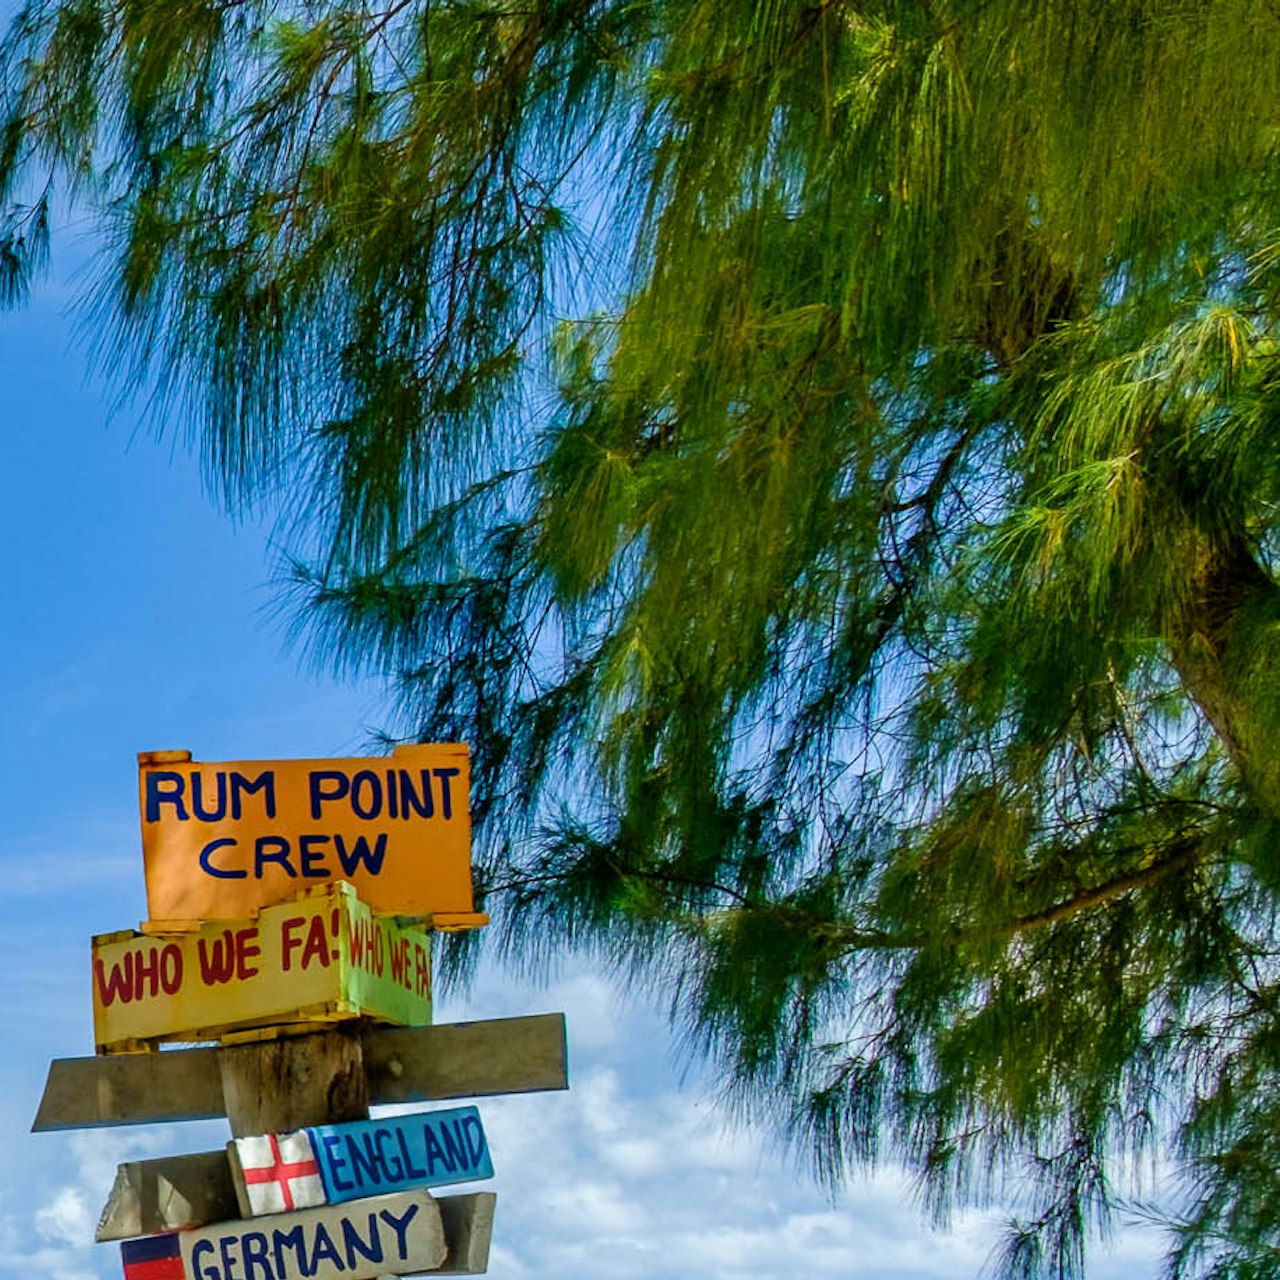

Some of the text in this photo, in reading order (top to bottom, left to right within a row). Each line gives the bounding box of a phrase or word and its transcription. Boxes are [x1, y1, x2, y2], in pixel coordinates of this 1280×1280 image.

[145, 768, 459, 823] RUM POINT
[199, 834, 387, 879] CREW
[96, 908, 339, 1007] WHO WE FA!
[347, 909, 384, 979] WHO
[387, 931, 412, 990] WE
[322, 1115, 484, 1191] ENGLAND
